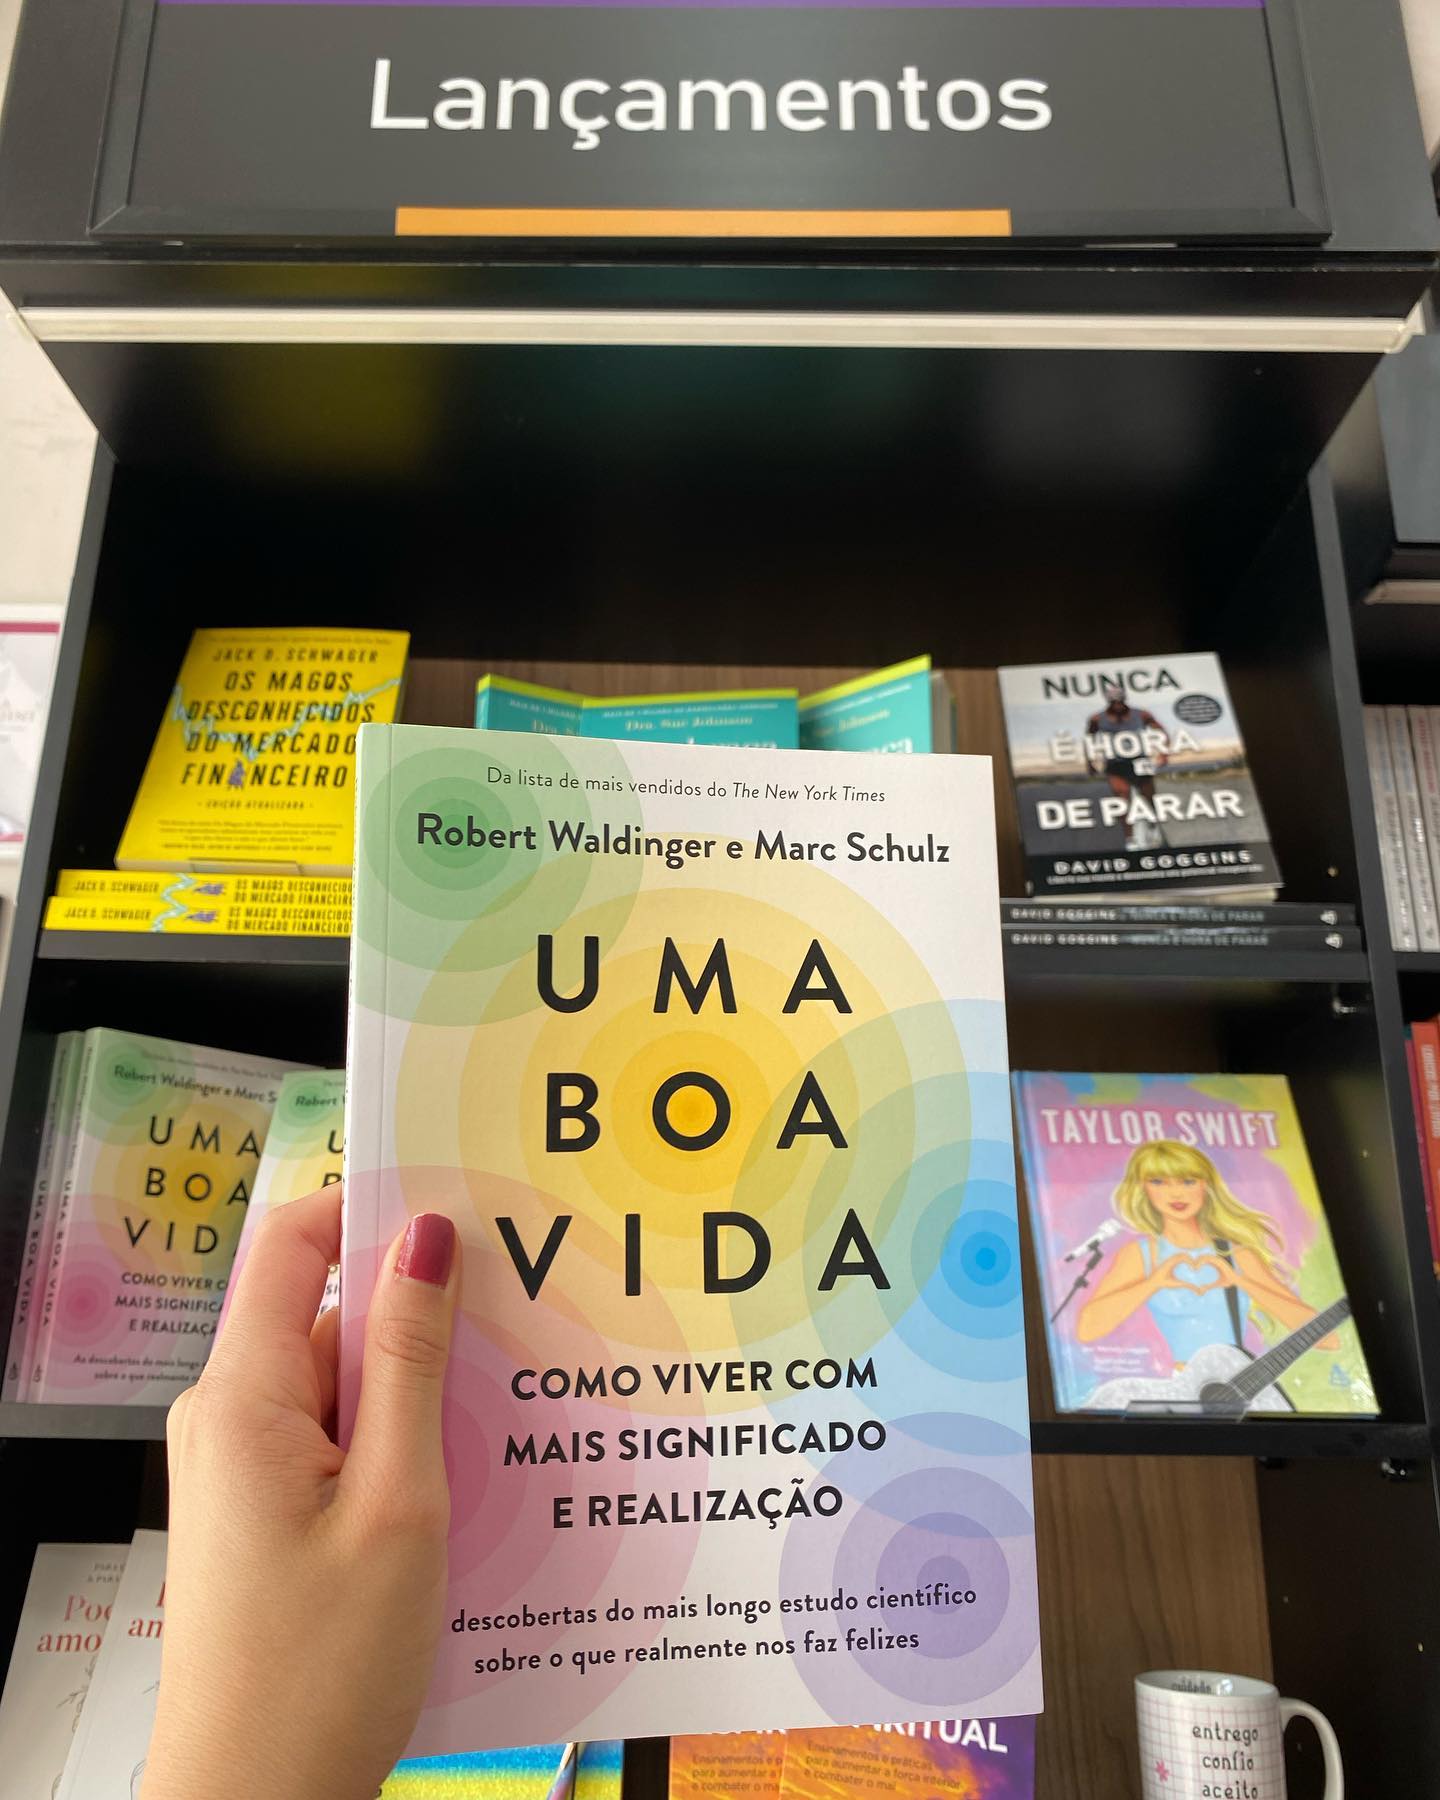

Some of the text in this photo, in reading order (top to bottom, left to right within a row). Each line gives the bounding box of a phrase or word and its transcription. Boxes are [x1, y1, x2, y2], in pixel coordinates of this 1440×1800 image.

[369, 57, 1053, 151] Lançamentos
[224, 671, 353, 691] OS MAGOS
[1042, 668, 1180, 700] NUNCA
[186, 701, 375, 723] DESCONHECIDOS
[185, 732, 356, 755] DO MERCADO
[1052, 728, 1200, 761] É HORA
[181, 761, 348, 788] FINNCEIRO
[487, 767, 886, 803] Da lista de mais vendidos do The New York Times
[1036, 789, 1244, 830] DE PARAR
[417, 812, 951, 870] Robert Waldinger e Marc Schulz
[1053, 858, 1130, 875] DAVID
[1139, 850, 1251, 870] GOGGINS
[288, 881, 352, 892] DESCONHECIDO
[537, 934, 853, 1014] UMA
[546, 1071, 848, 1152] BOA
[1041, 1108, 1280, 1148] TAYLOR SWIFT
[150, 1115, 262, 1160] UMA
[144, 1167, 251, 1207] BOA
[124, 1216, 220, 1254] VID
[495, 1208, 891, 1301] VIDA
[121, 1272, 167, 1287] COMO
[171, 1275, 212, 1290] VIVER
[114, 1295, 151, 1309] MAIS
[129, 1318, 137, 1331] E
[511, 1357, 878, 1400] COMO VIVER COM
[503, 1420, 887, 1466] MAIS SIGNIFICADO
[553, 1478, 843, 1530] E REALIZAÇÃO
[451, 1582, 977, 1633] descobertas do mais longo estudo científico
[474, 1627, 920, 1675] sobre o que realmente nos faz felizes
[1192, 1722, 1259, 1747] entrego
[1202, 1751, 1254, 1770] confio
[1202, 1780, 1258, 1800] aceito
